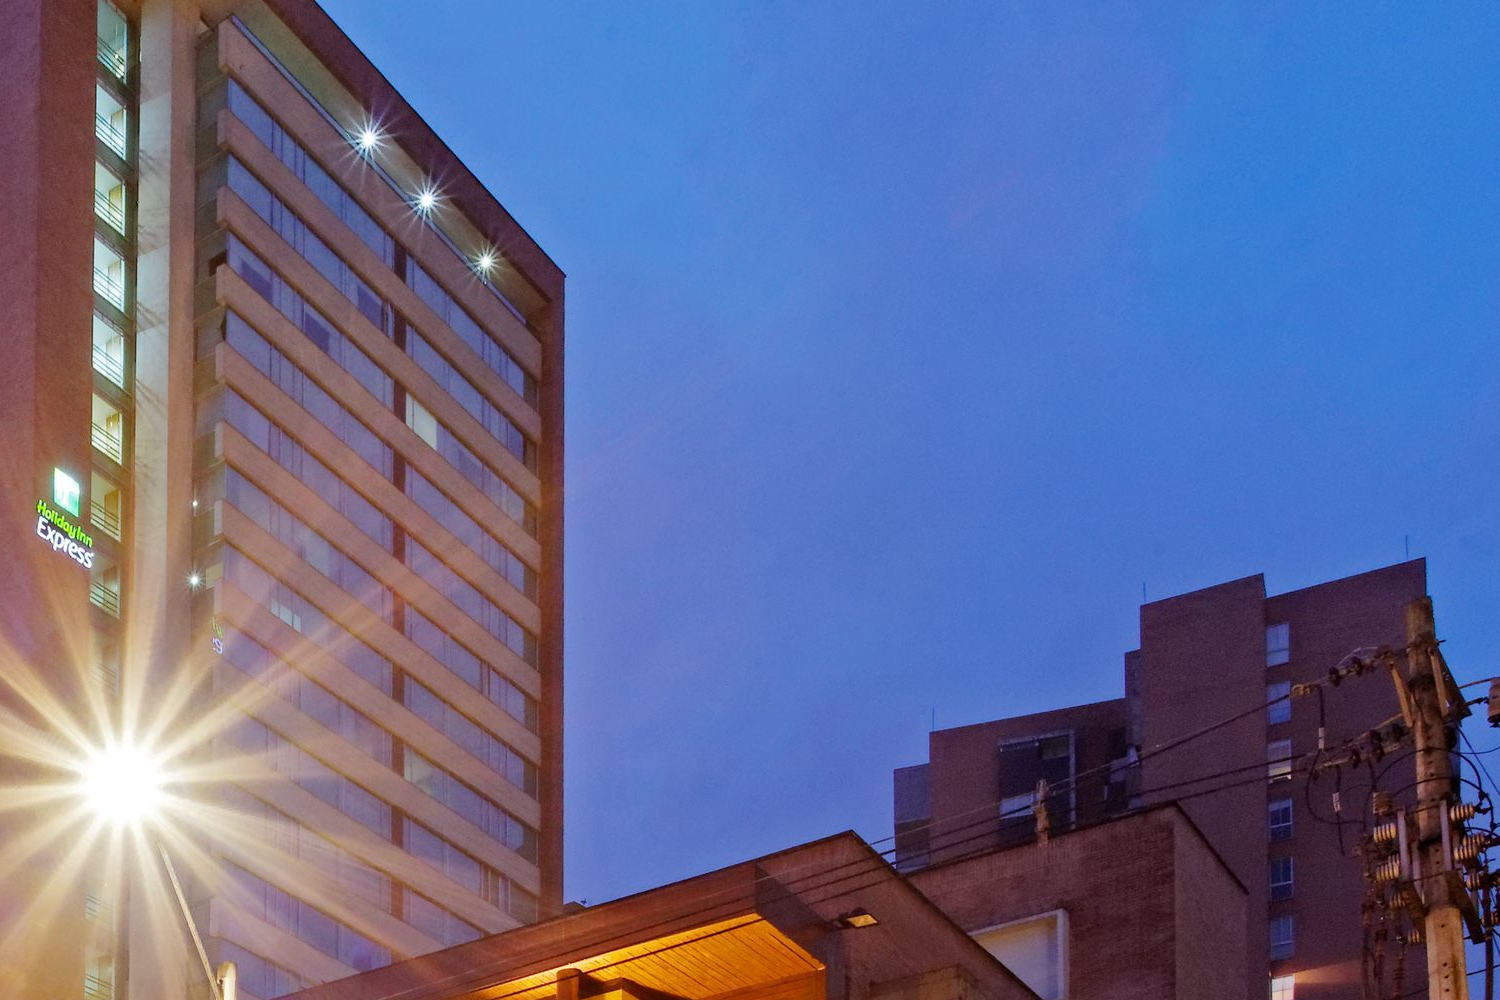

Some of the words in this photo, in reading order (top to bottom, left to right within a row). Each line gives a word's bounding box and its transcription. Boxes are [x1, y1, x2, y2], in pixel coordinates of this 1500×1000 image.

[36, 516, 94, 569] Express
[37, 500, 76, 539] Holiday
[76, 527, 93, 548] Inn
